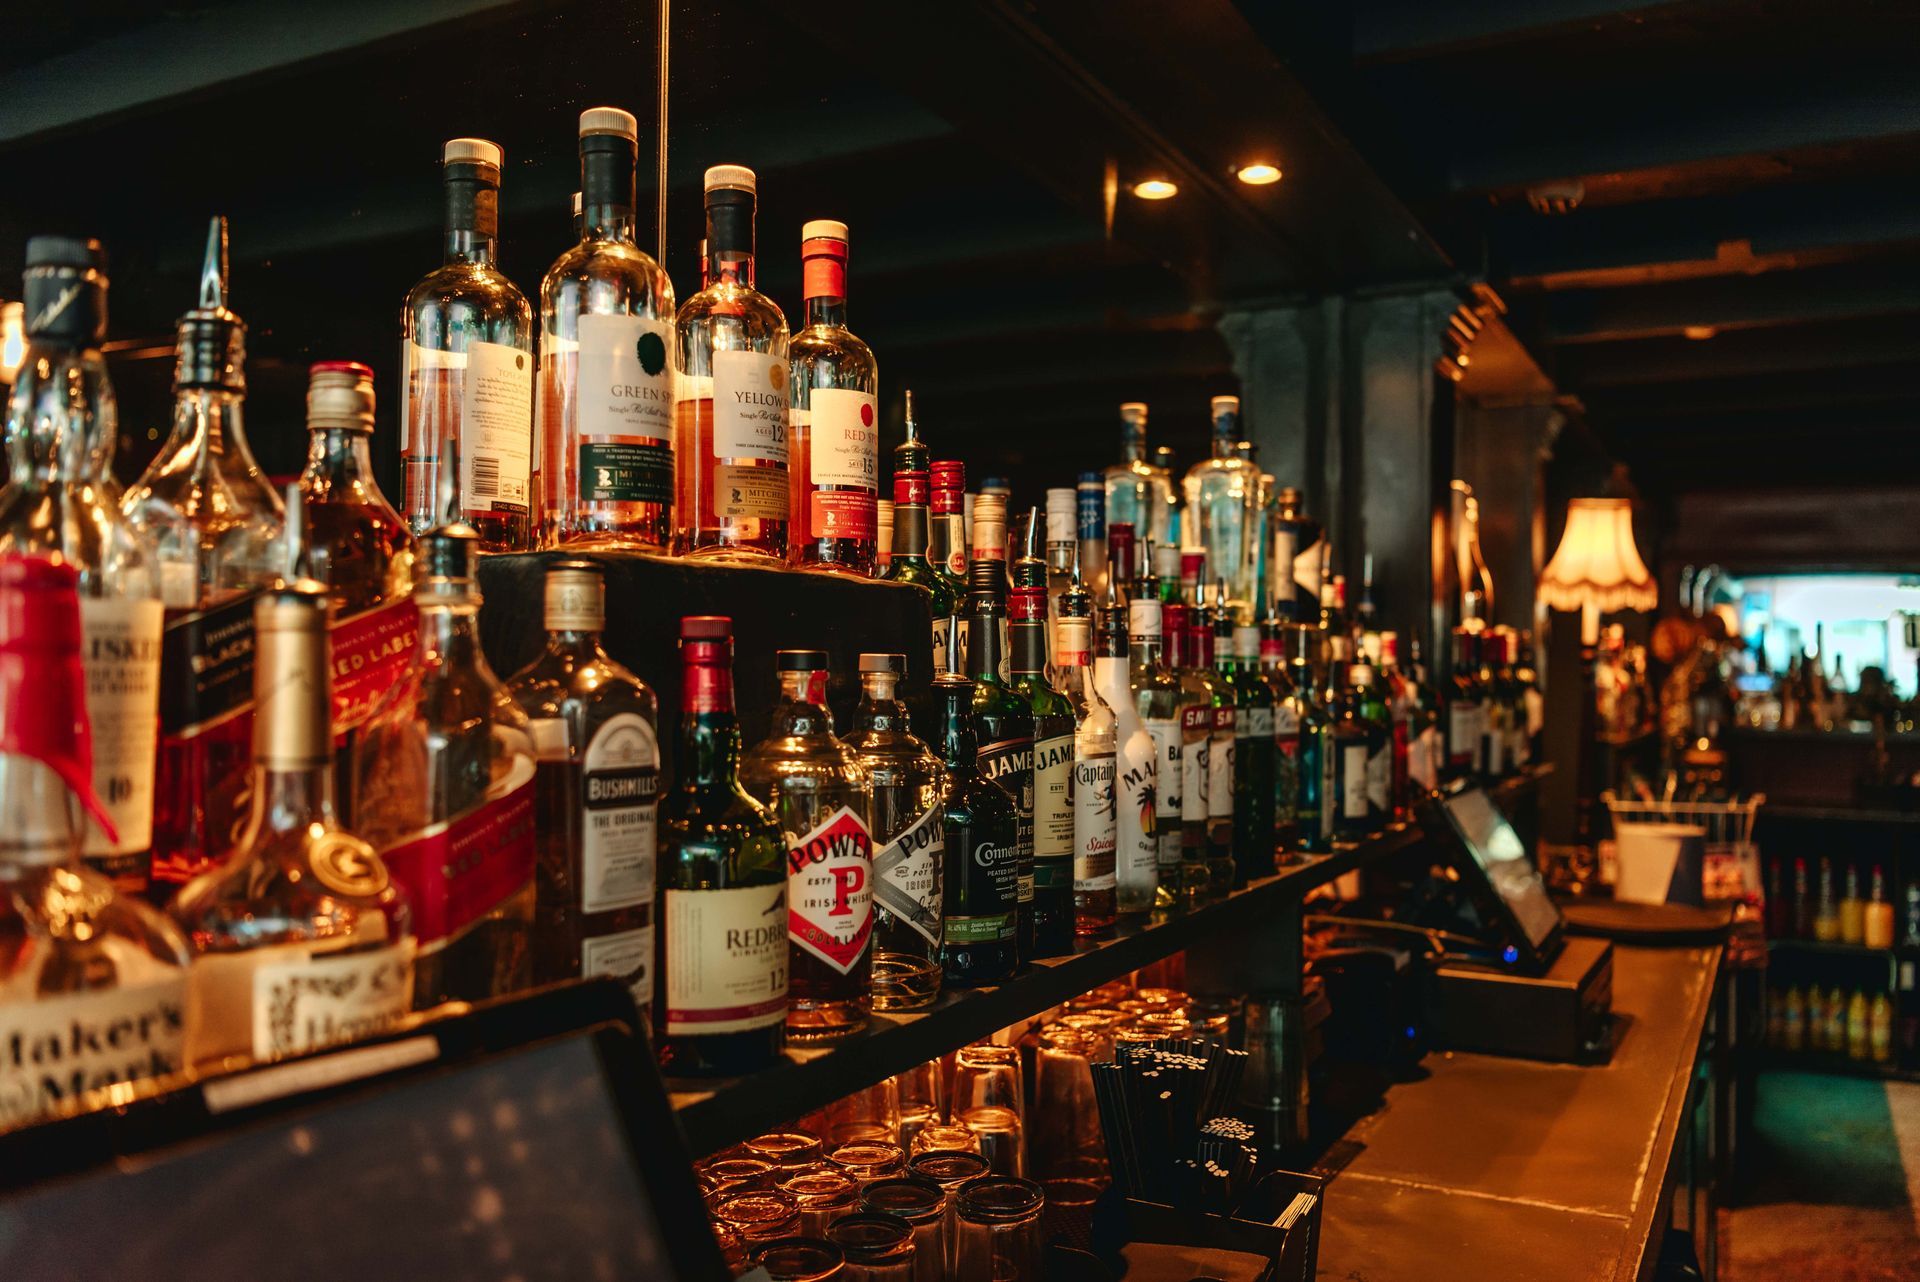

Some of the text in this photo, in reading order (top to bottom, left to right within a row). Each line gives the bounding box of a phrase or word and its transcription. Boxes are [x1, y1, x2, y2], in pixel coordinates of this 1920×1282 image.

[611, 385, 659, 401] GREEN
[735, 391, 783, 408] YELLOW
[740, 412, 758, 420] Single
[755, 424, 784, 443] AGED 12
[844, 429, 866, 442] RED
[863, 457, 874, 475] 15
[588, 776, 658, 801] BUSHMILLS
[987, 868, 1007, 877] PEATED
[804, 896, 838, 909] IRISH
[808, 928, 840, 947] GOLD
[770, 967, 785, 992] 12
